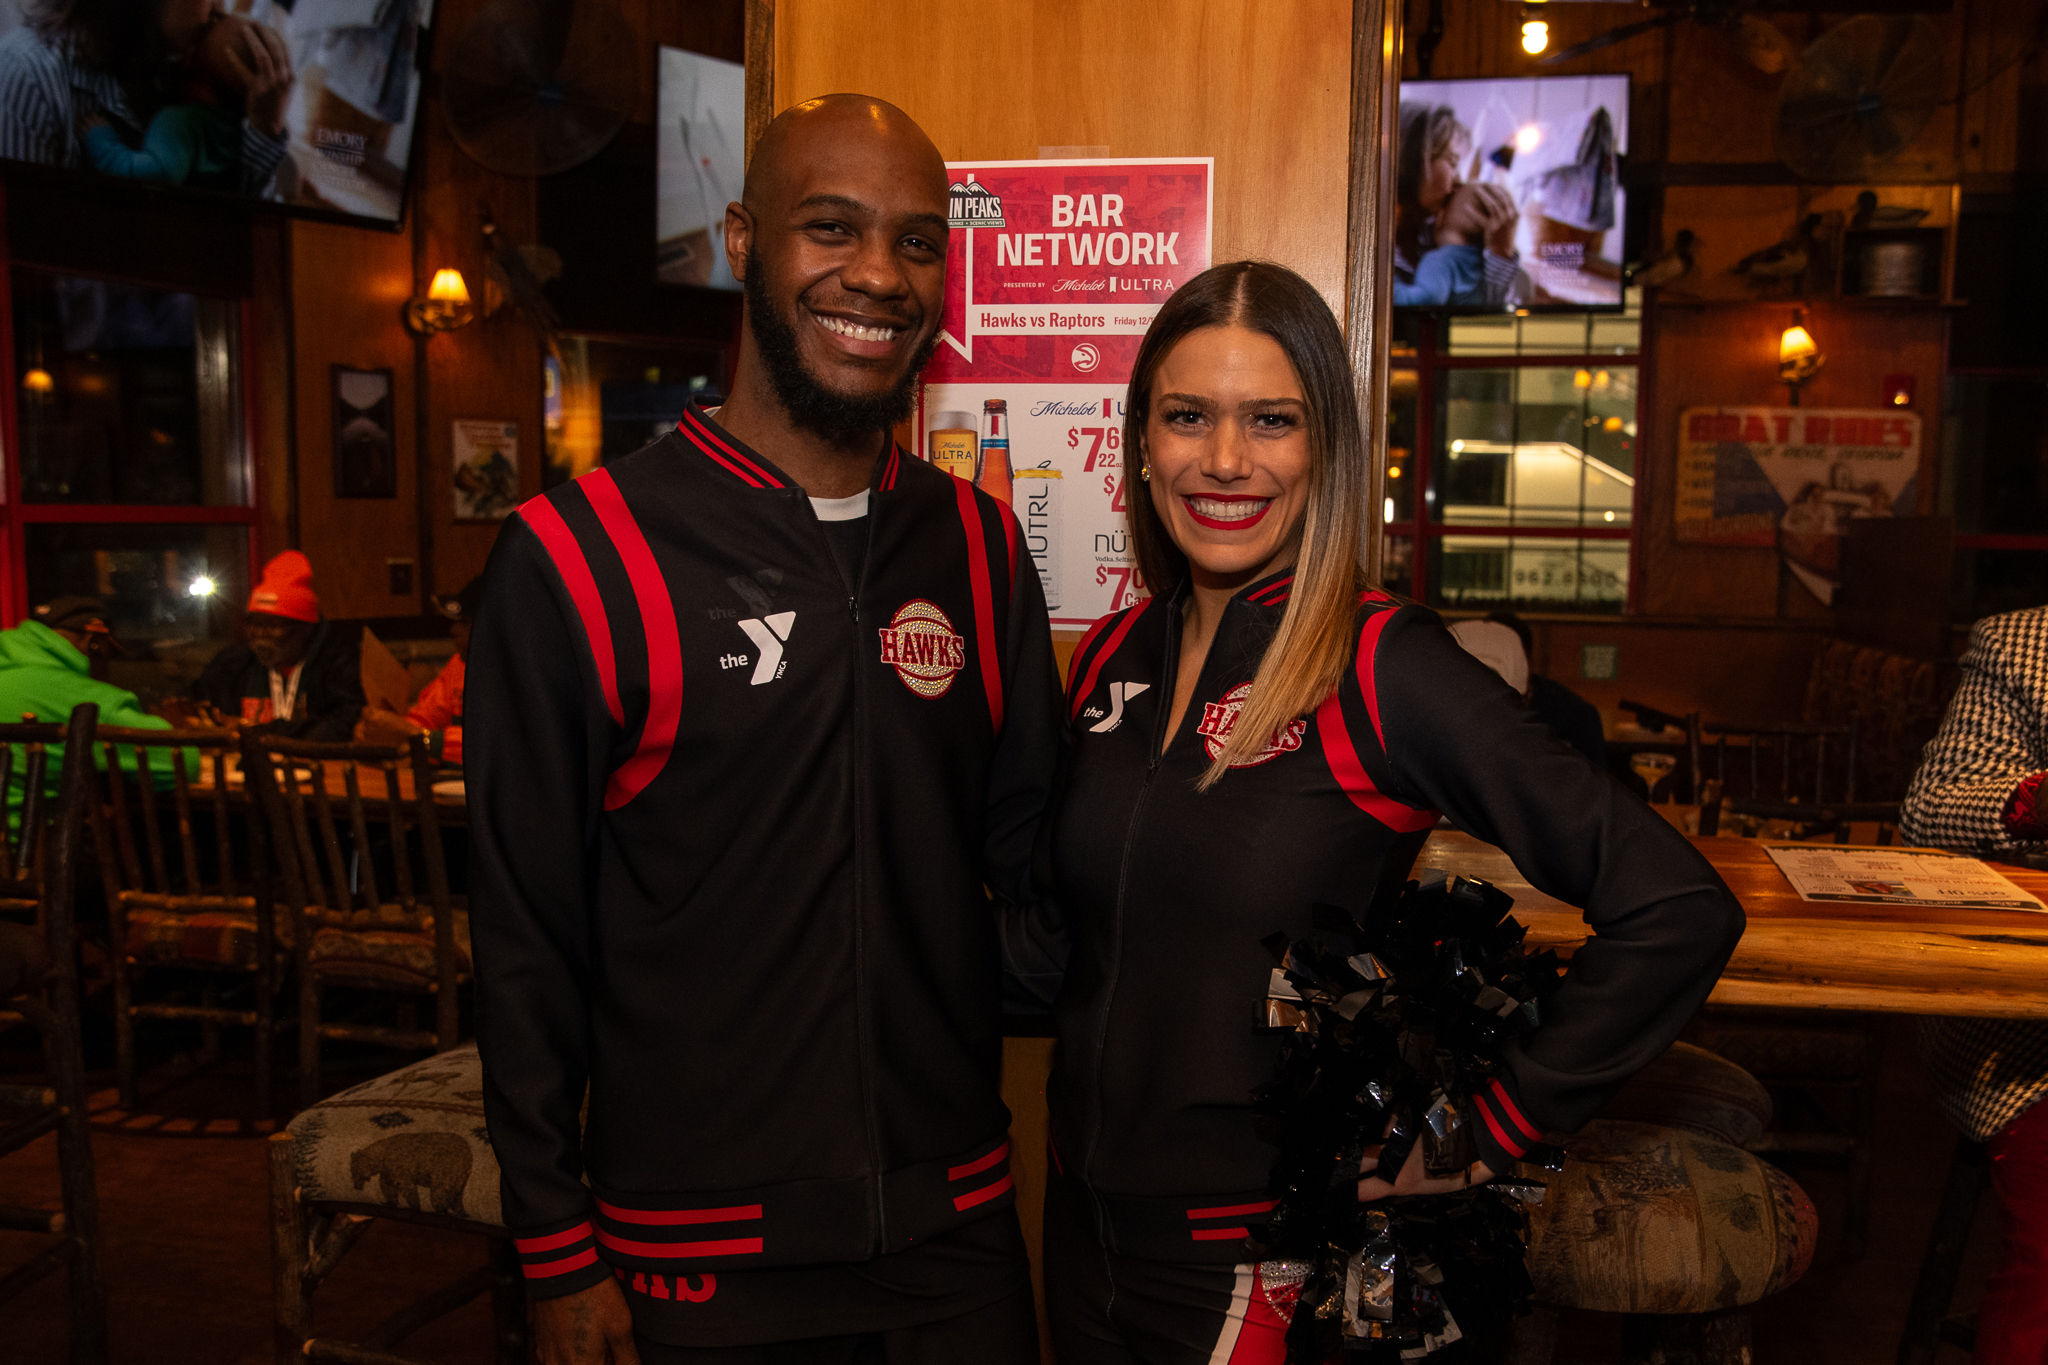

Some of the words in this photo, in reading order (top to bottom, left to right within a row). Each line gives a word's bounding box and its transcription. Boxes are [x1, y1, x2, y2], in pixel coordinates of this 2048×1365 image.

[965, 197, 1002, 218] PEAKS
[1052, 194, 1124, 227] BAR
[997, 232, 1179, 266] NETWORK
[1052, 279, 1107, 292] Michelob
[1121, 279, 1174, 291] ULTRA
[980, 312, 1026, 328] Hawks
[1030, 317, 1045, 328] vs
[1049, 312, 1105, 330] Raptors
[1114, 317, 1137, 326] Friday
[1139, 317, 1155, 325] 12/1
[1030, 401, 1099, 416] Michelob
[933, 451, 972, 460] ULTRA
[1067, 426, 1125, 472] $76
[1125, 593, 1143, 606] Ca
[879, 628, 964, 669] HAWKS
[720, 653, 748, 670] the
[775, 661, 787, 679] YMCA
[1083, 707, 1104, 718] the
